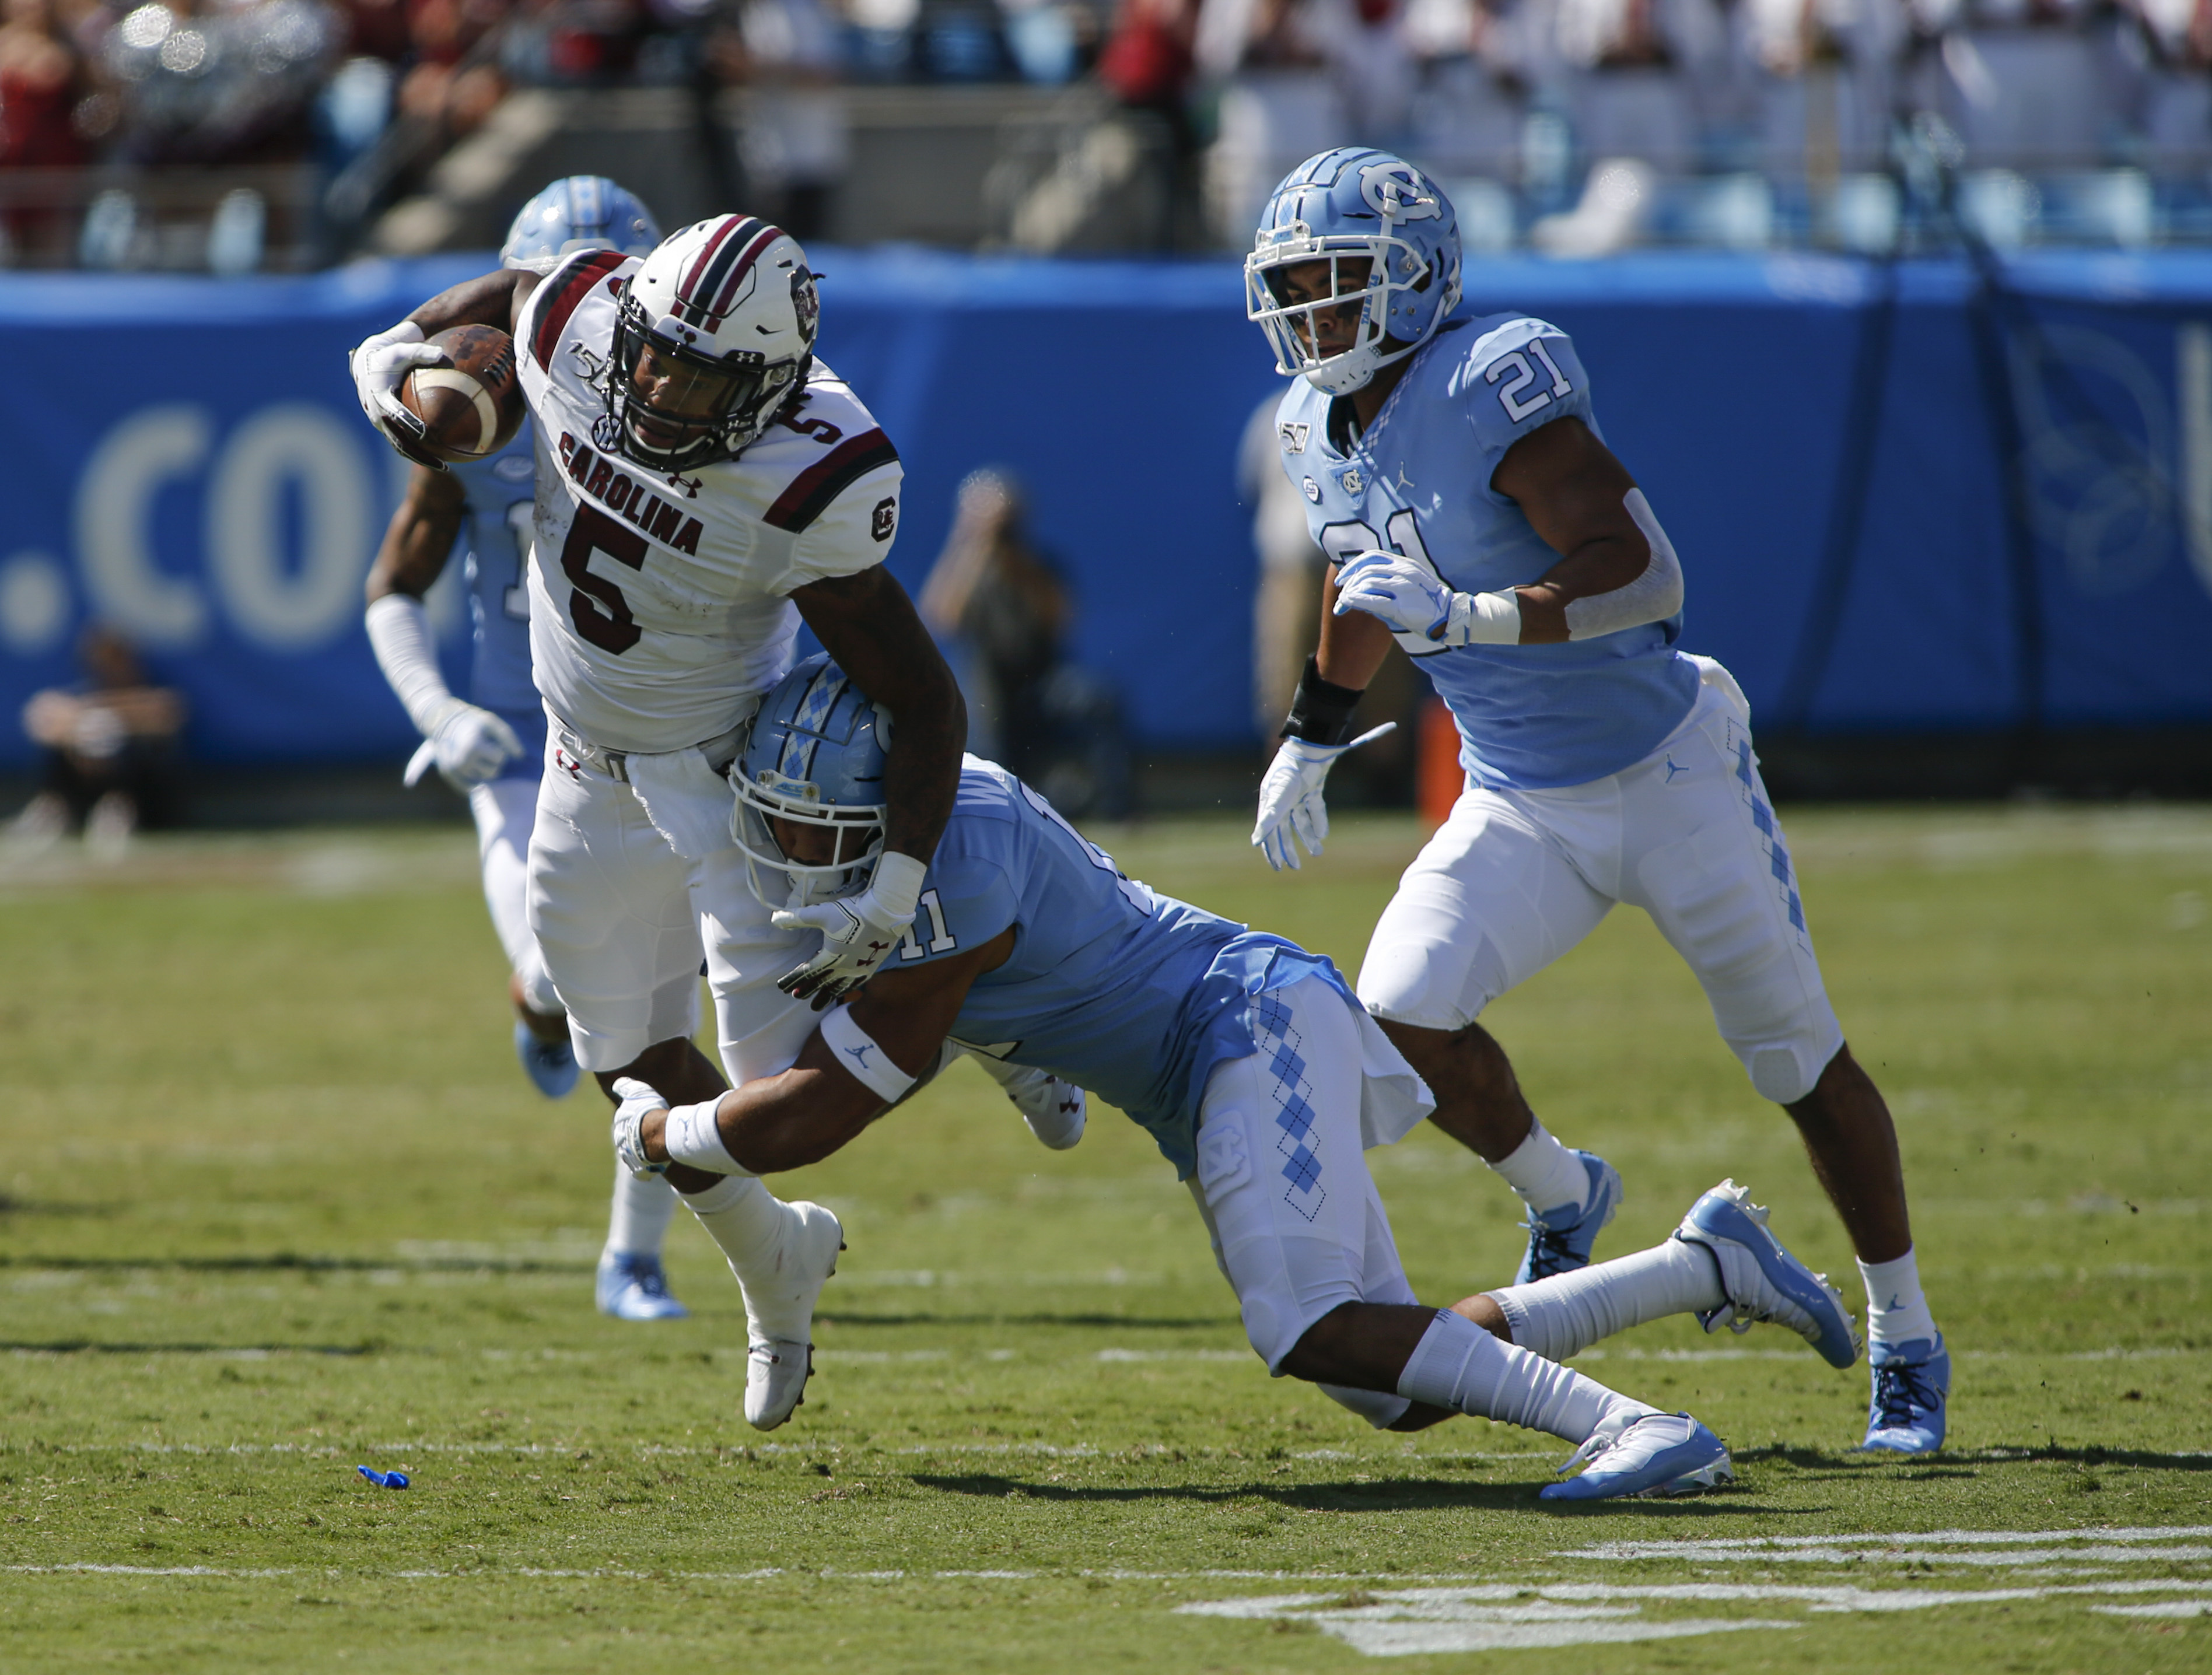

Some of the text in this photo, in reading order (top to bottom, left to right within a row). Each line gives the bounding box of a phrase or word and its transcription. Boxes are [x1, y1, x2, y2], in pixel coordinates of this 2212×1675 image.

[779, 400, 844, 445] 5
[1483, 337, 1574, 425] 21
[559, 432, 704, 557] CAROLINA
[561, 499, 650, 656] 5
[899, 887, 958, 962] 11
